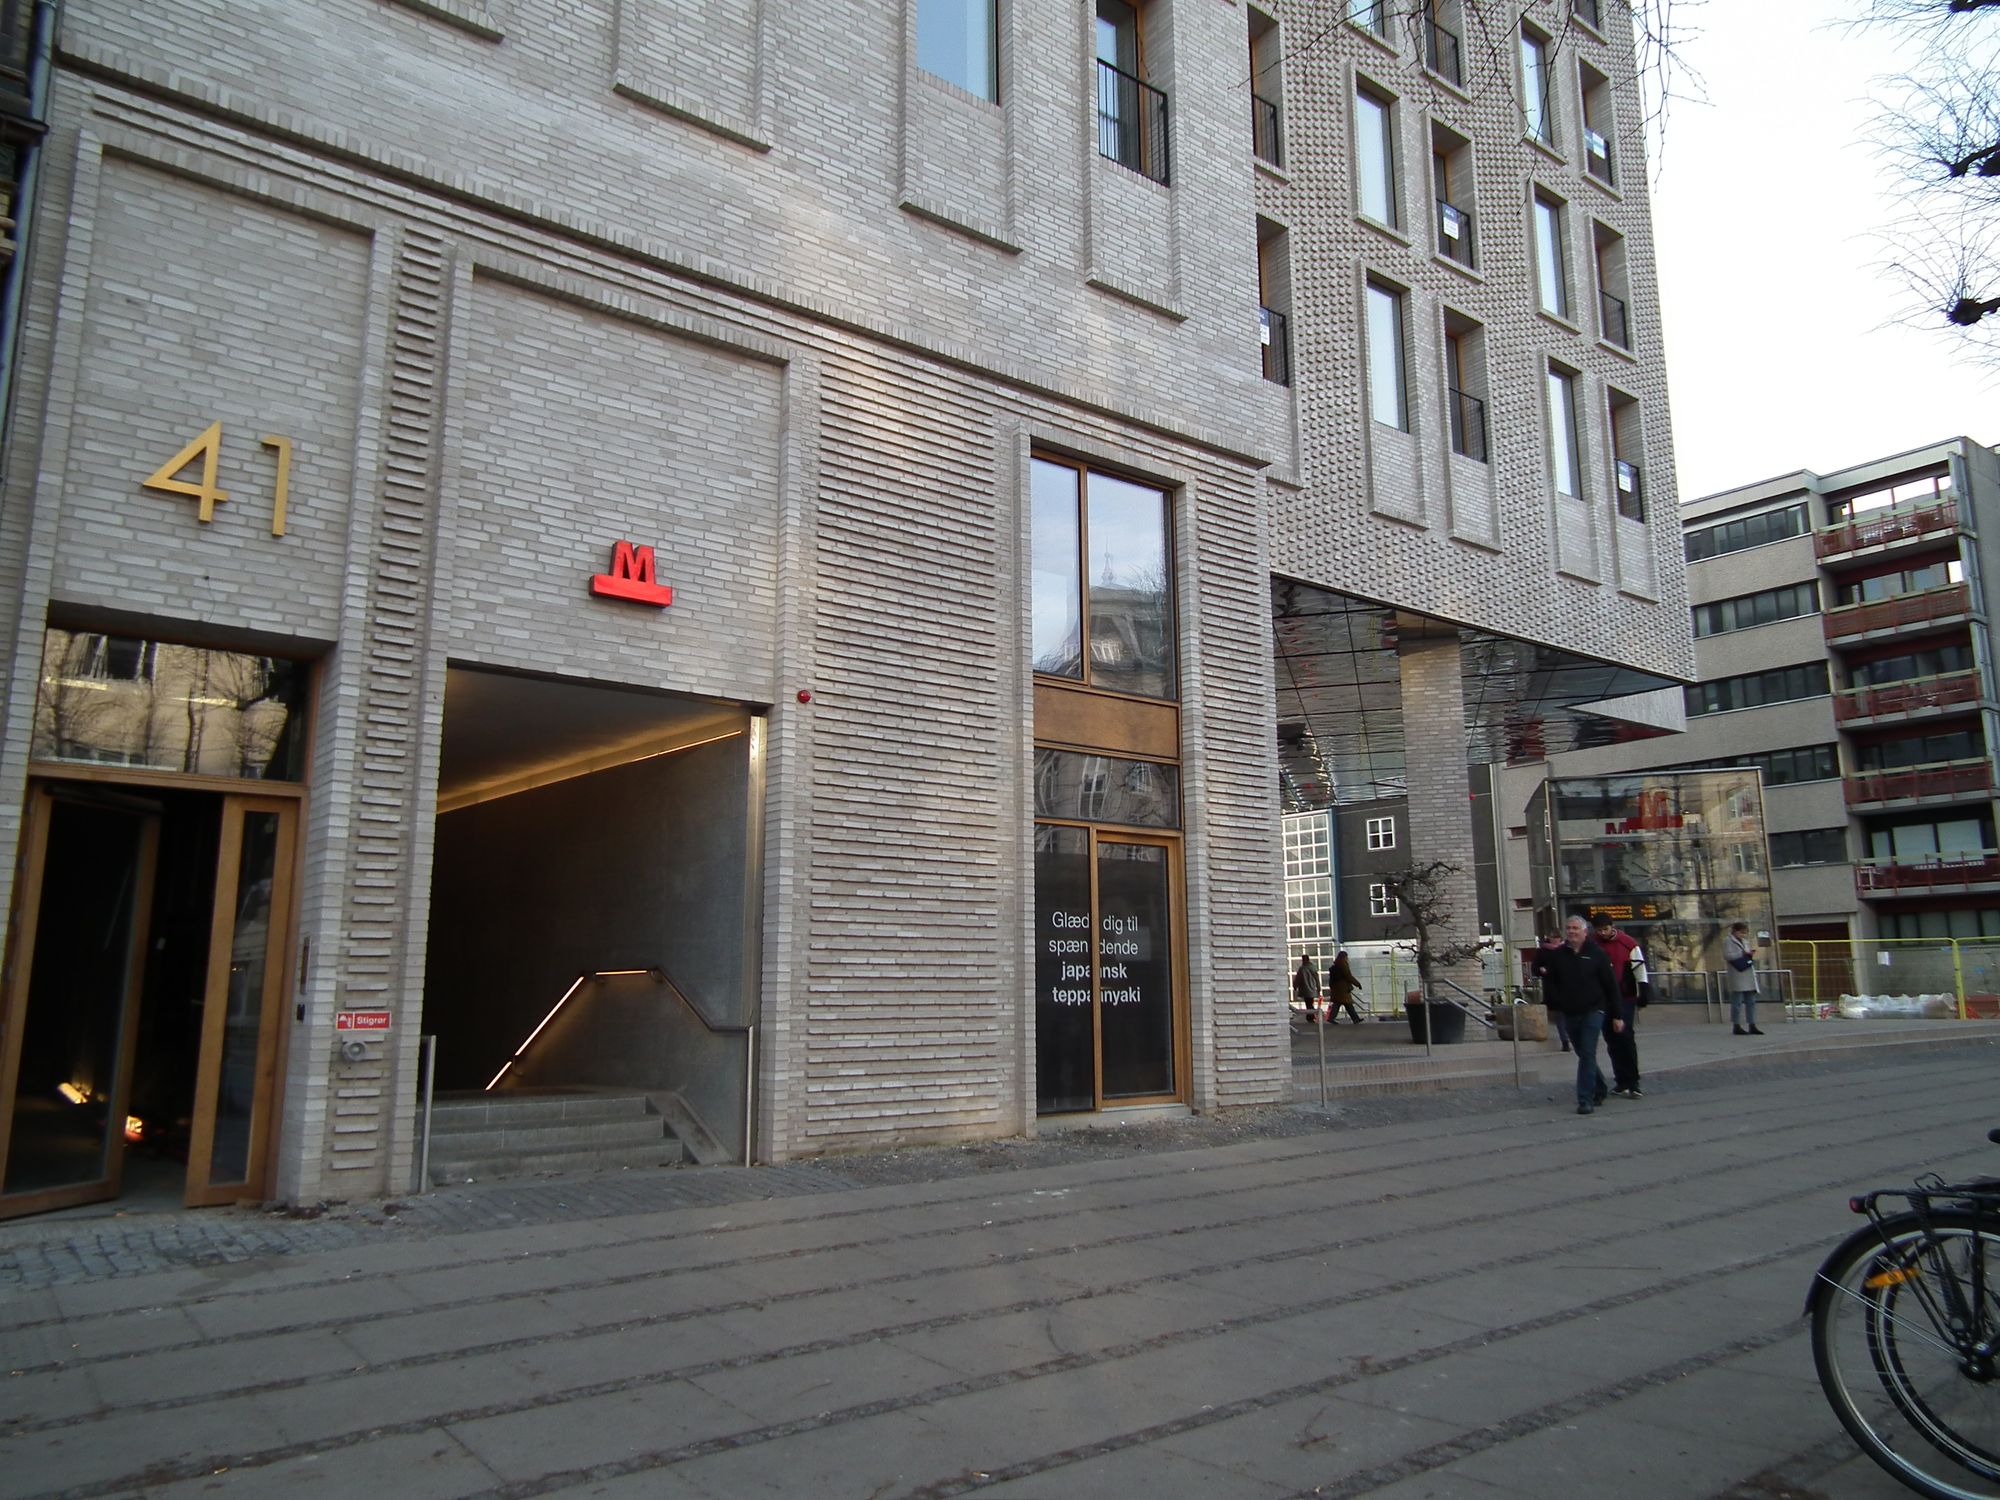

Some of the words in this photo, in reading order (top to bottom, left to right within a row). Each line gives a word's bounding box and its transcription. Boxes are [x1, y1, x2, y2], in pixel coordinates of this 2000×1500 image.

[142, 418, 292, 537] 41
[1052, 911, 1090, 928] Glæd
[1103, 915, 1123, 935] dig
[1127, 916, 1138, 932] til
